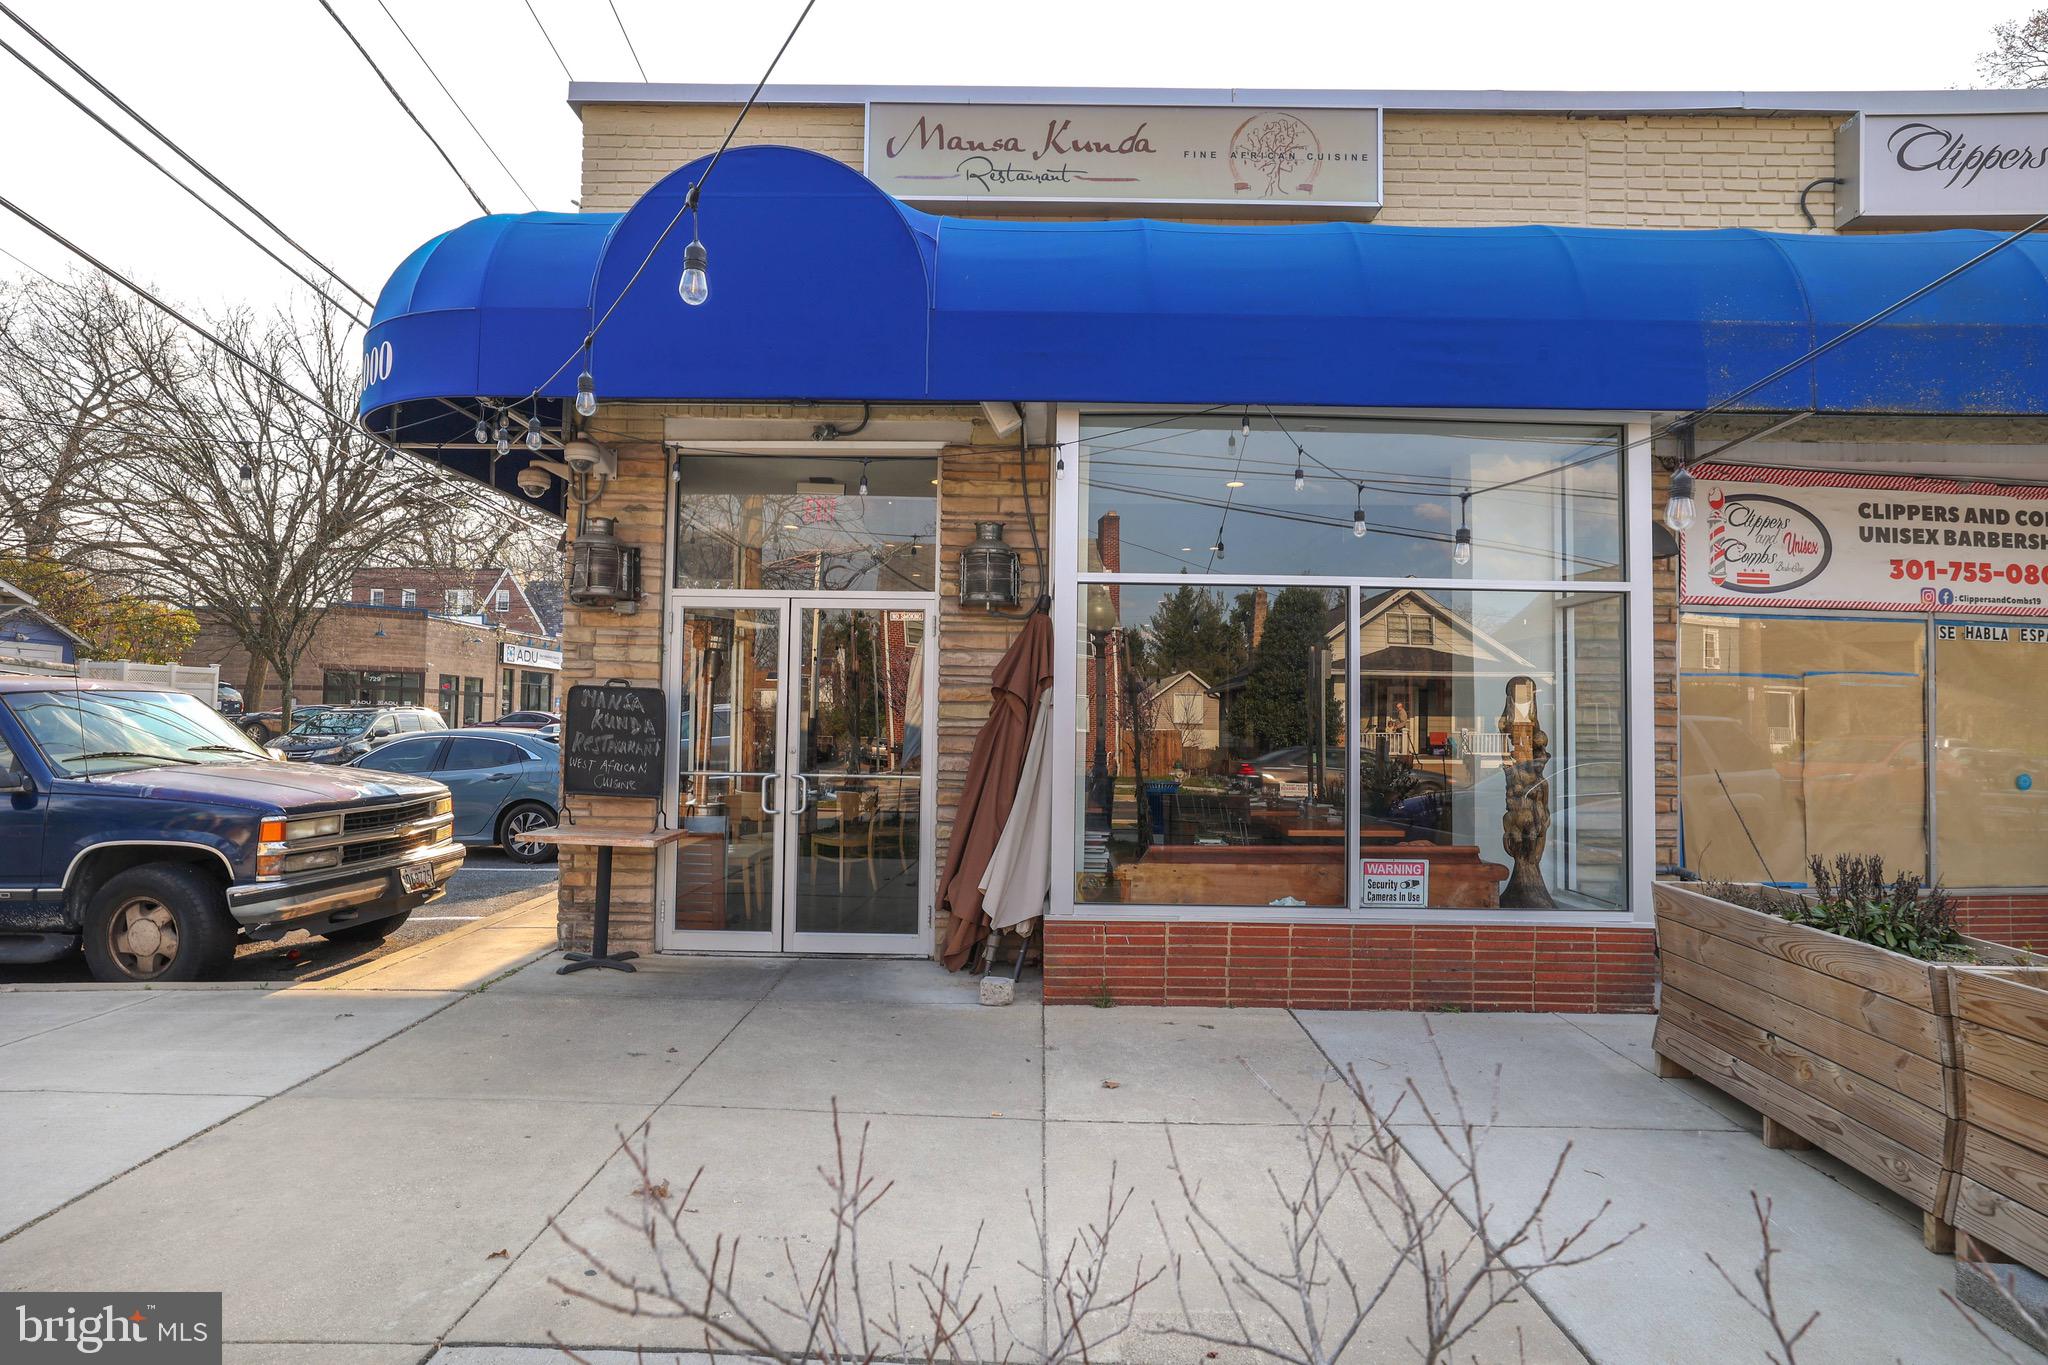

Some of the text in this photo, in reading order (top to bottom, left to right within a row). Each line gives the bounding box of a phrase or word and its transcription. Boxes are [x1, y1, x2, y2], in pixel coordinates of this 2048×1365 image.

[887, 116, 1157, 161] Mansa Kunda
[1184, 150, 1369, 162] FINE AFRICAN CUISINE
[1887, 123, 2048, 189] Clippers
[956, 156, 1088, 192] Restaurant
[1724, 502, 1790, 536] Clippers
[1858, 502, 2048, 527] CLIPPERS AND CO
[1755, 531, 1780, 546] and
[1783, 531, 1818, 557] Unisex
[1859, 526, 1940, 546] UNISEX
[1720, 538, 1778, 567] Combs
[1940, 626, 2048, 642] SE HABLA ESP
[516, 650, 538, 663] ADU
[569, 756, 647, 775] WEST AFRICAN
[1367, 864, 1421, 874] WARNING
[1367, 879, 1397, 891] Security
[1367, 891, 1420, 902] Cameras In Use
